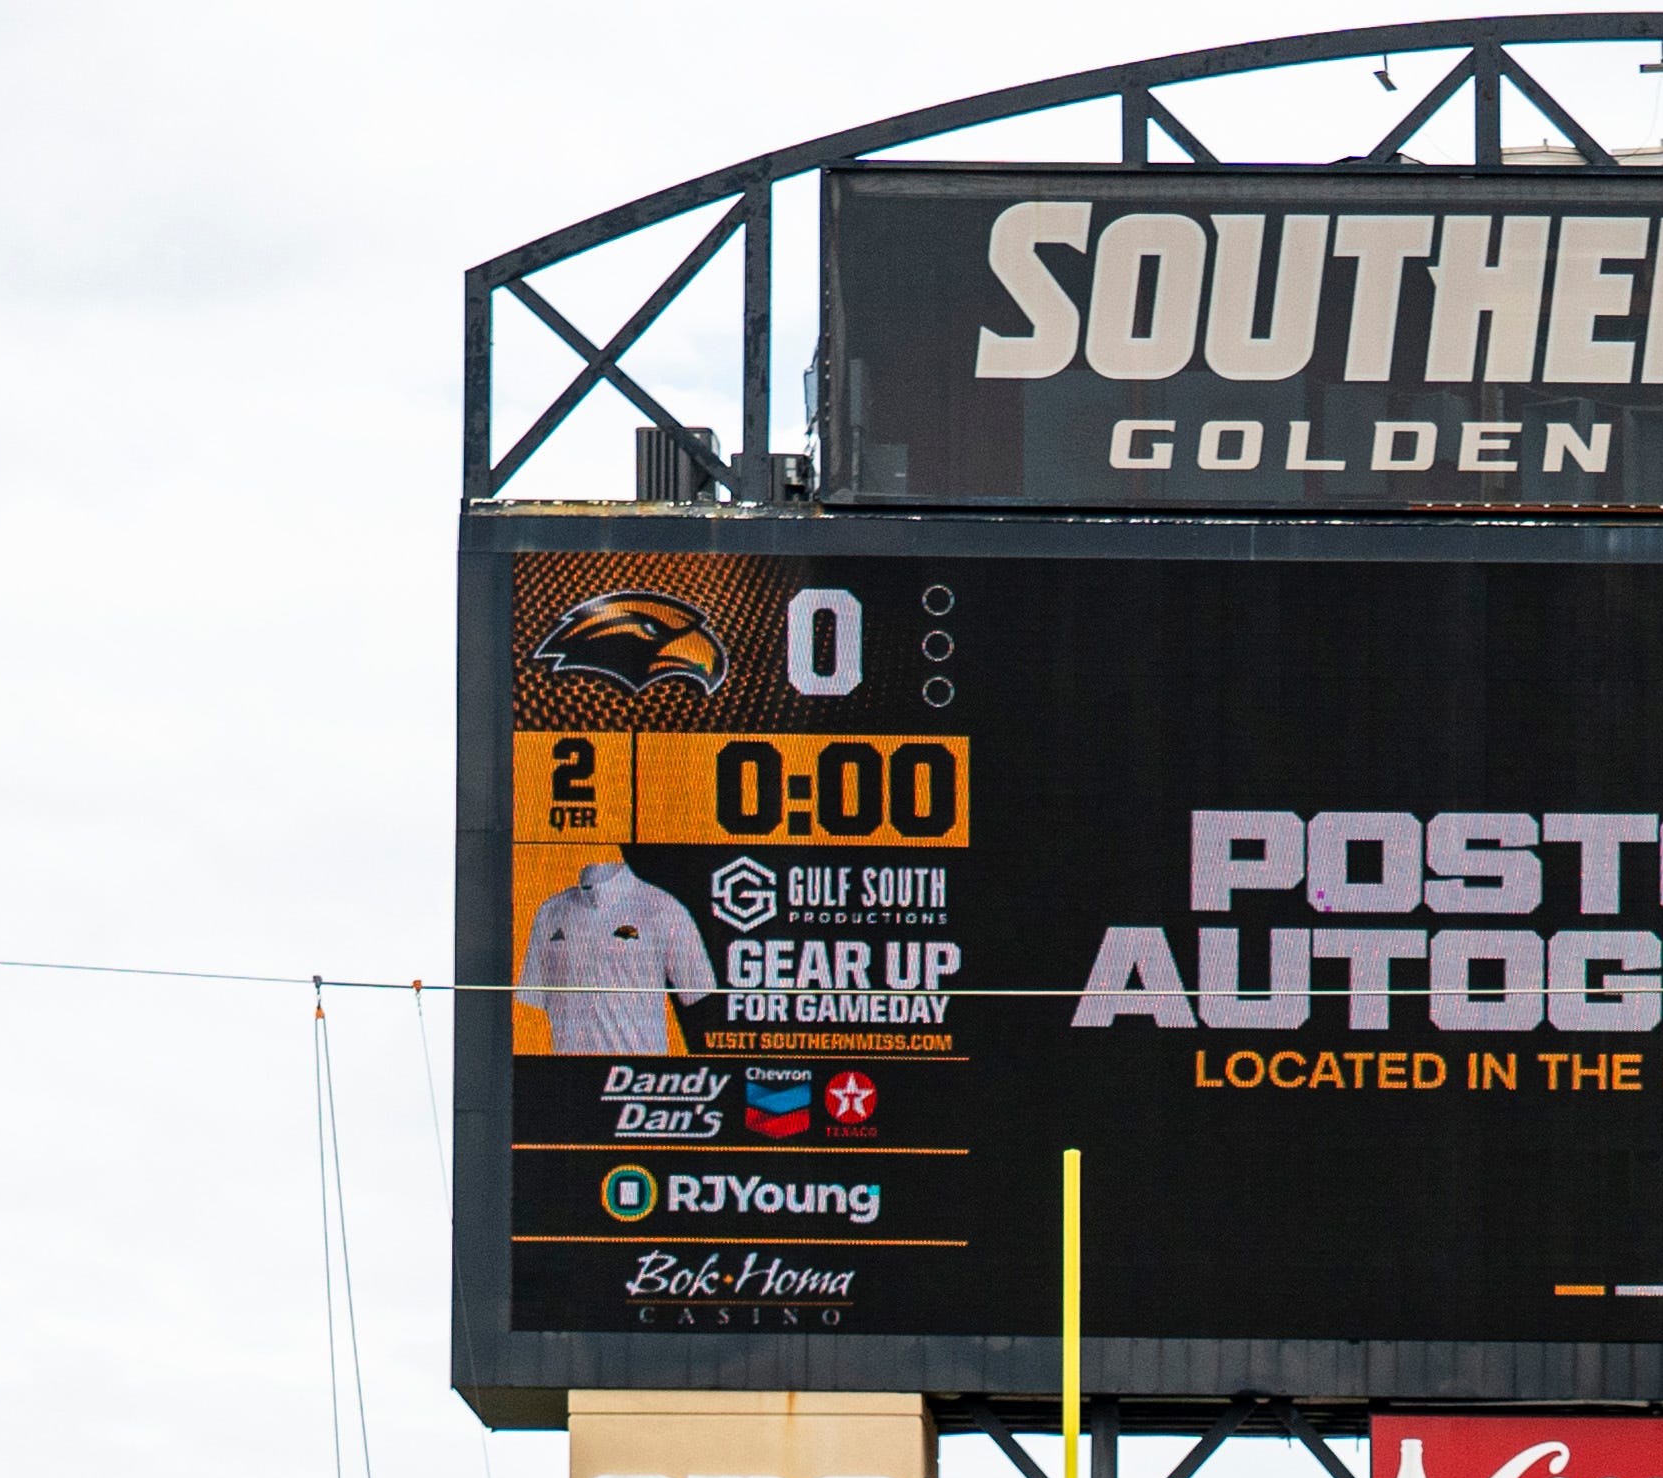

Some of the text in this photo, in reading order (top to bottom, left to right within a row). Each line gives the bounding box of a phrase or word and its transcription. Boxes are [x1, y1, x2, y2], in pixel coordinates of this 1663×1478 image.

[1109, 420, 1613, 472] GOLDEN
[787, 588, 863, 696] 0
[551, 737, 597, 803] 2
[715, 740, 957, 838] 0:00
[788, 866, 946, 909] GULF SOUTH
[788, 911, 948, 925] PRODUCTIONS
[726, 939, 962, 991] GEAR UP
[727, 993, 950, 1024] FOR GAMEDAY
[704, 1031, 953, 1051] VISIT SOUTHERNMISS.COM
[603, 1065, 731, 1101] Dandy
[745, 1067, 813, 1081] Chevron
[1194, 1050, 1447, 1090] LOCATED
[1467, 1051, 1518, 1090] IN
[1537, 1052, 1643, 1091] THE
[615, 1103, 724, 1138] Dan's
[667, 1175, 881, 1224] RJYoung
[638, 1307, 842, 1326] CASINO
